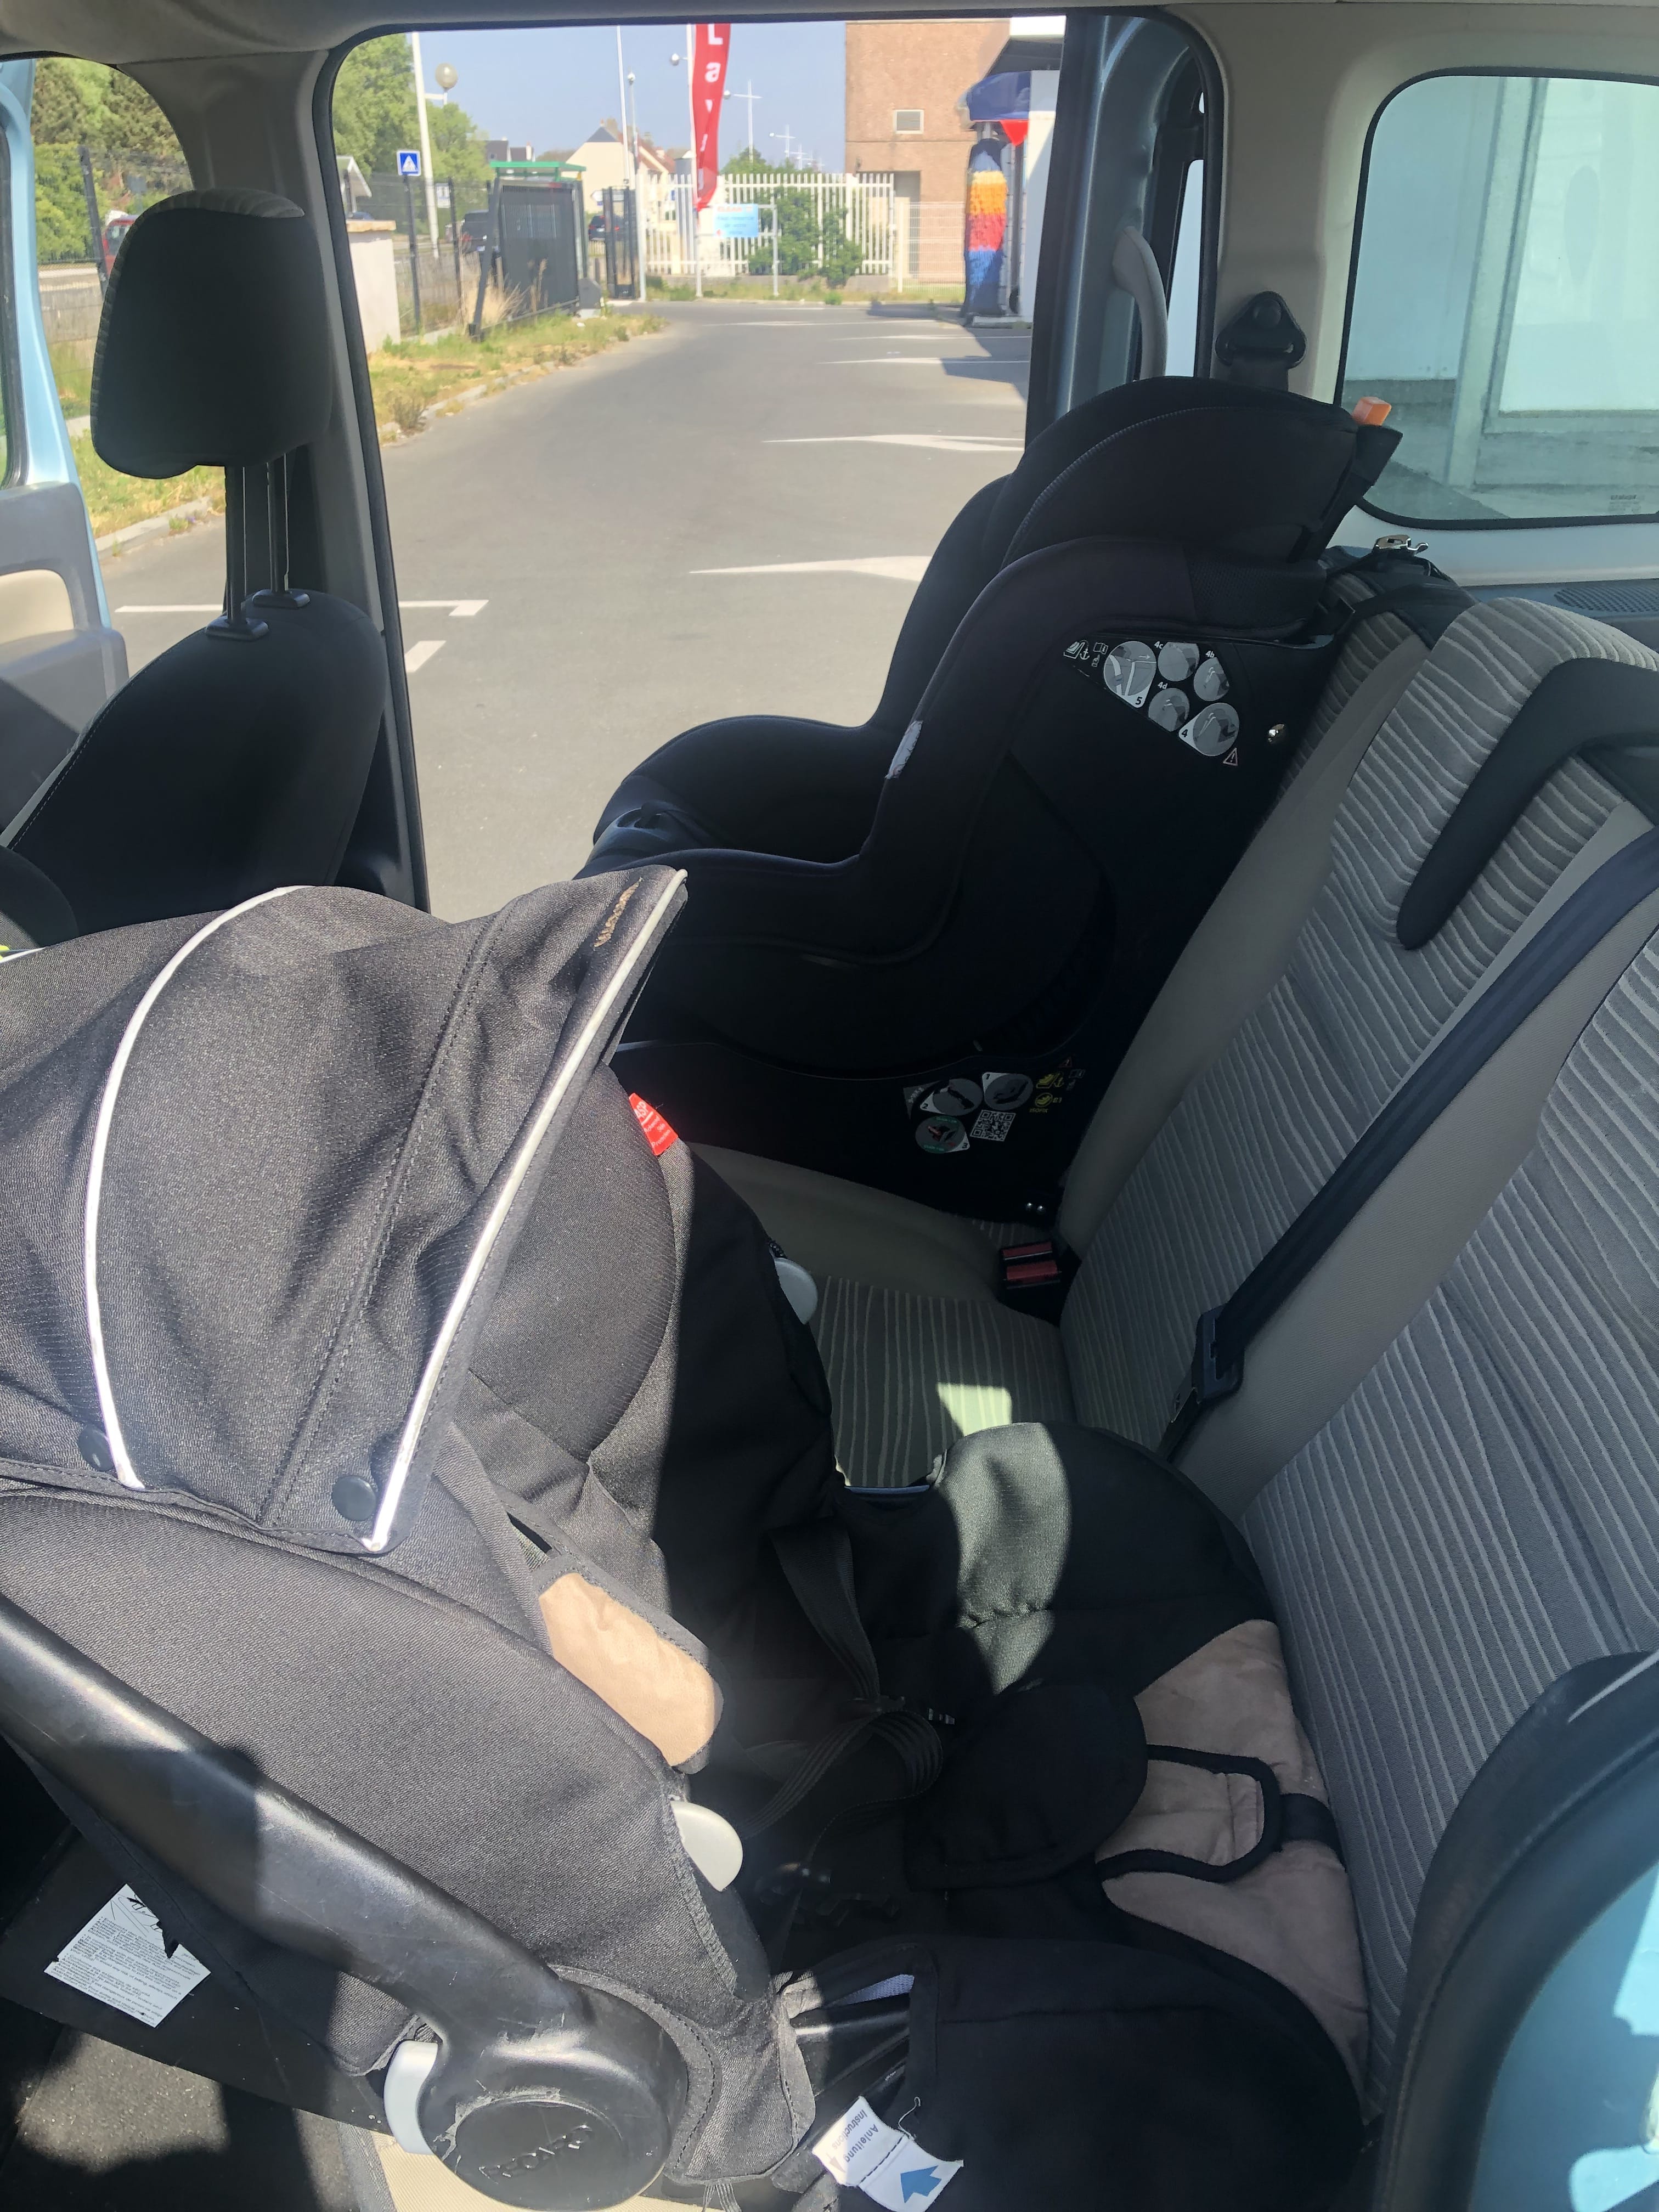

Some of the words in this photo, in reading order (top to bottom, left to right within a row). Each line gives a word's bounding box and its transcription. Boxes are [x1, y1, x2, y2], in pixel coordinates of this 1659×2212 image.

[1154, 641, 1164, 649] 4c
[1135, 696, 1143, 705] 5
[1181, 729, 1188, 738] 4
[634, 1101, 648, 1119] ASP
[832, 2109, 868, 2149] Instructions
[843, 2124, 879, 2163] Anleitung
